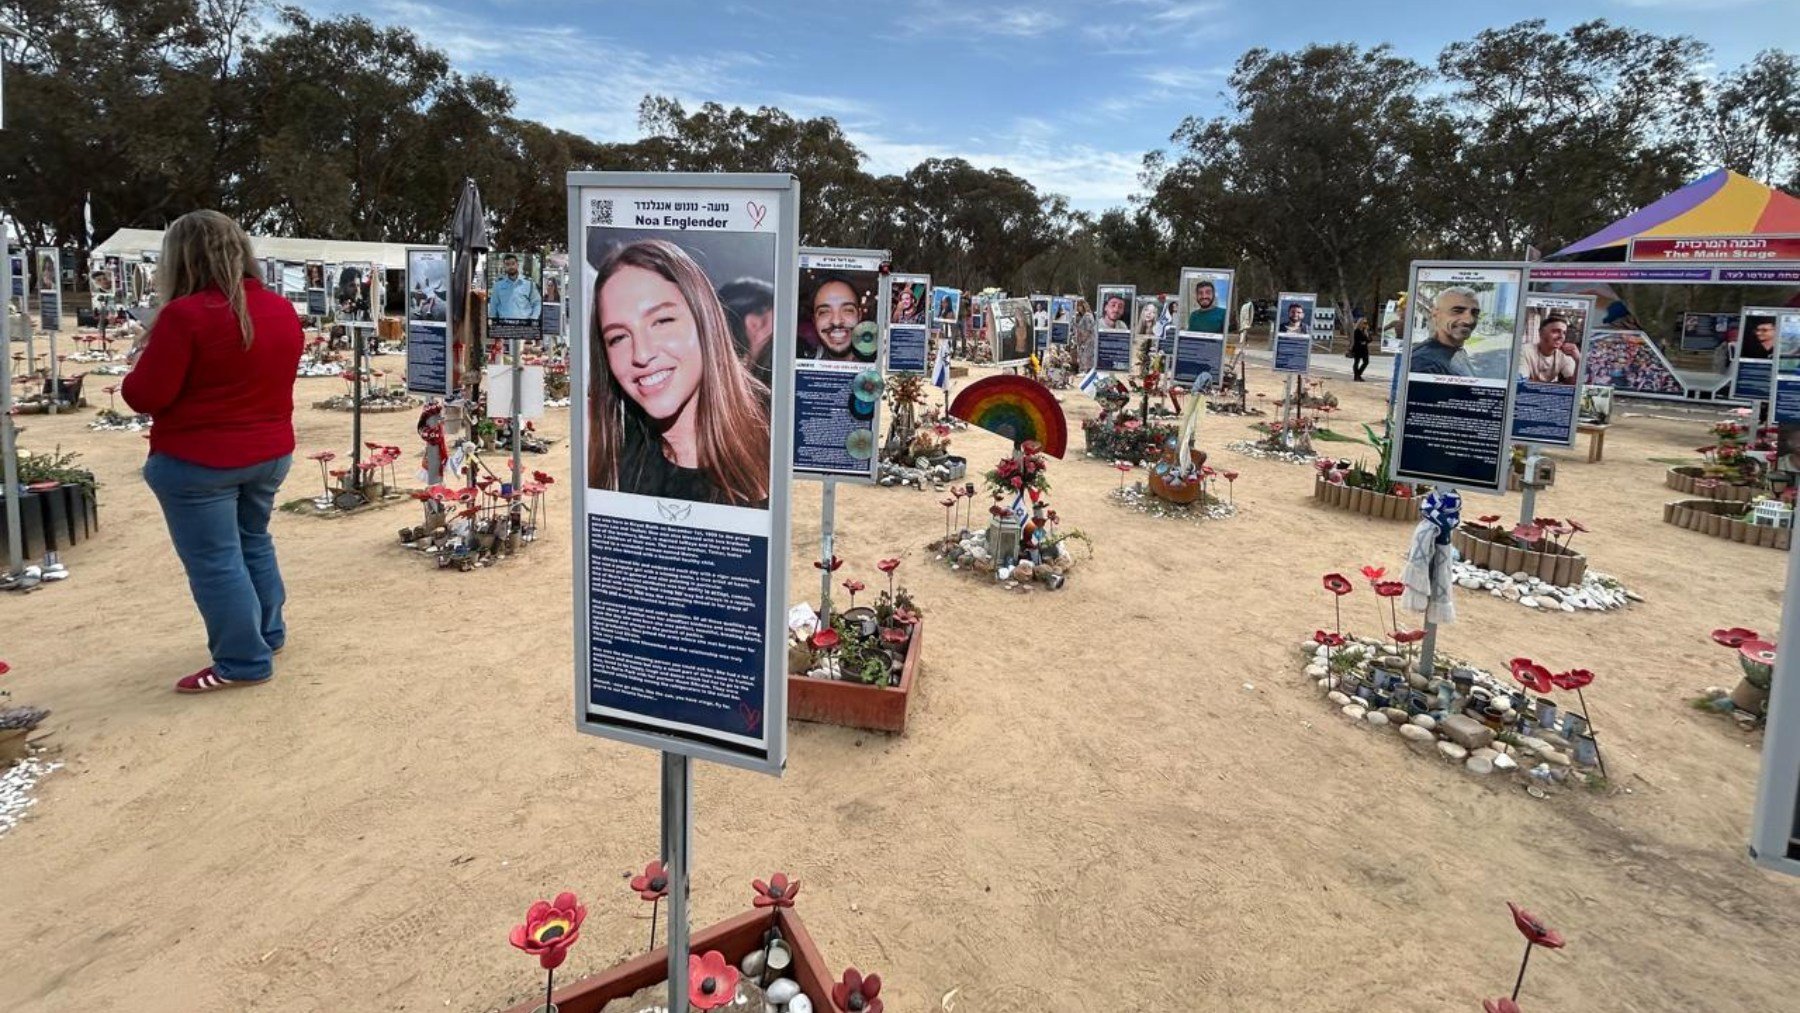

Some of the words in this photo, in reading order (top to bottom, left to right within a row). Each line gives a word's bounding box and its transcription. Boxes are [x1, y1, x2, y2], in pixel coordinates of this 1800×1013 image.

[634, 201, 671, 211] אנגלנדר
[635, 216, 659, 226] Noa
[664, 216, 728, 229] Englender
[1674, 240, 1727, 249] המרכזית
[1730, 240, 1766, 248] הבמה
[1664, 250, 1690, 258] The
[1732, 250, 1776, 259] Stage
